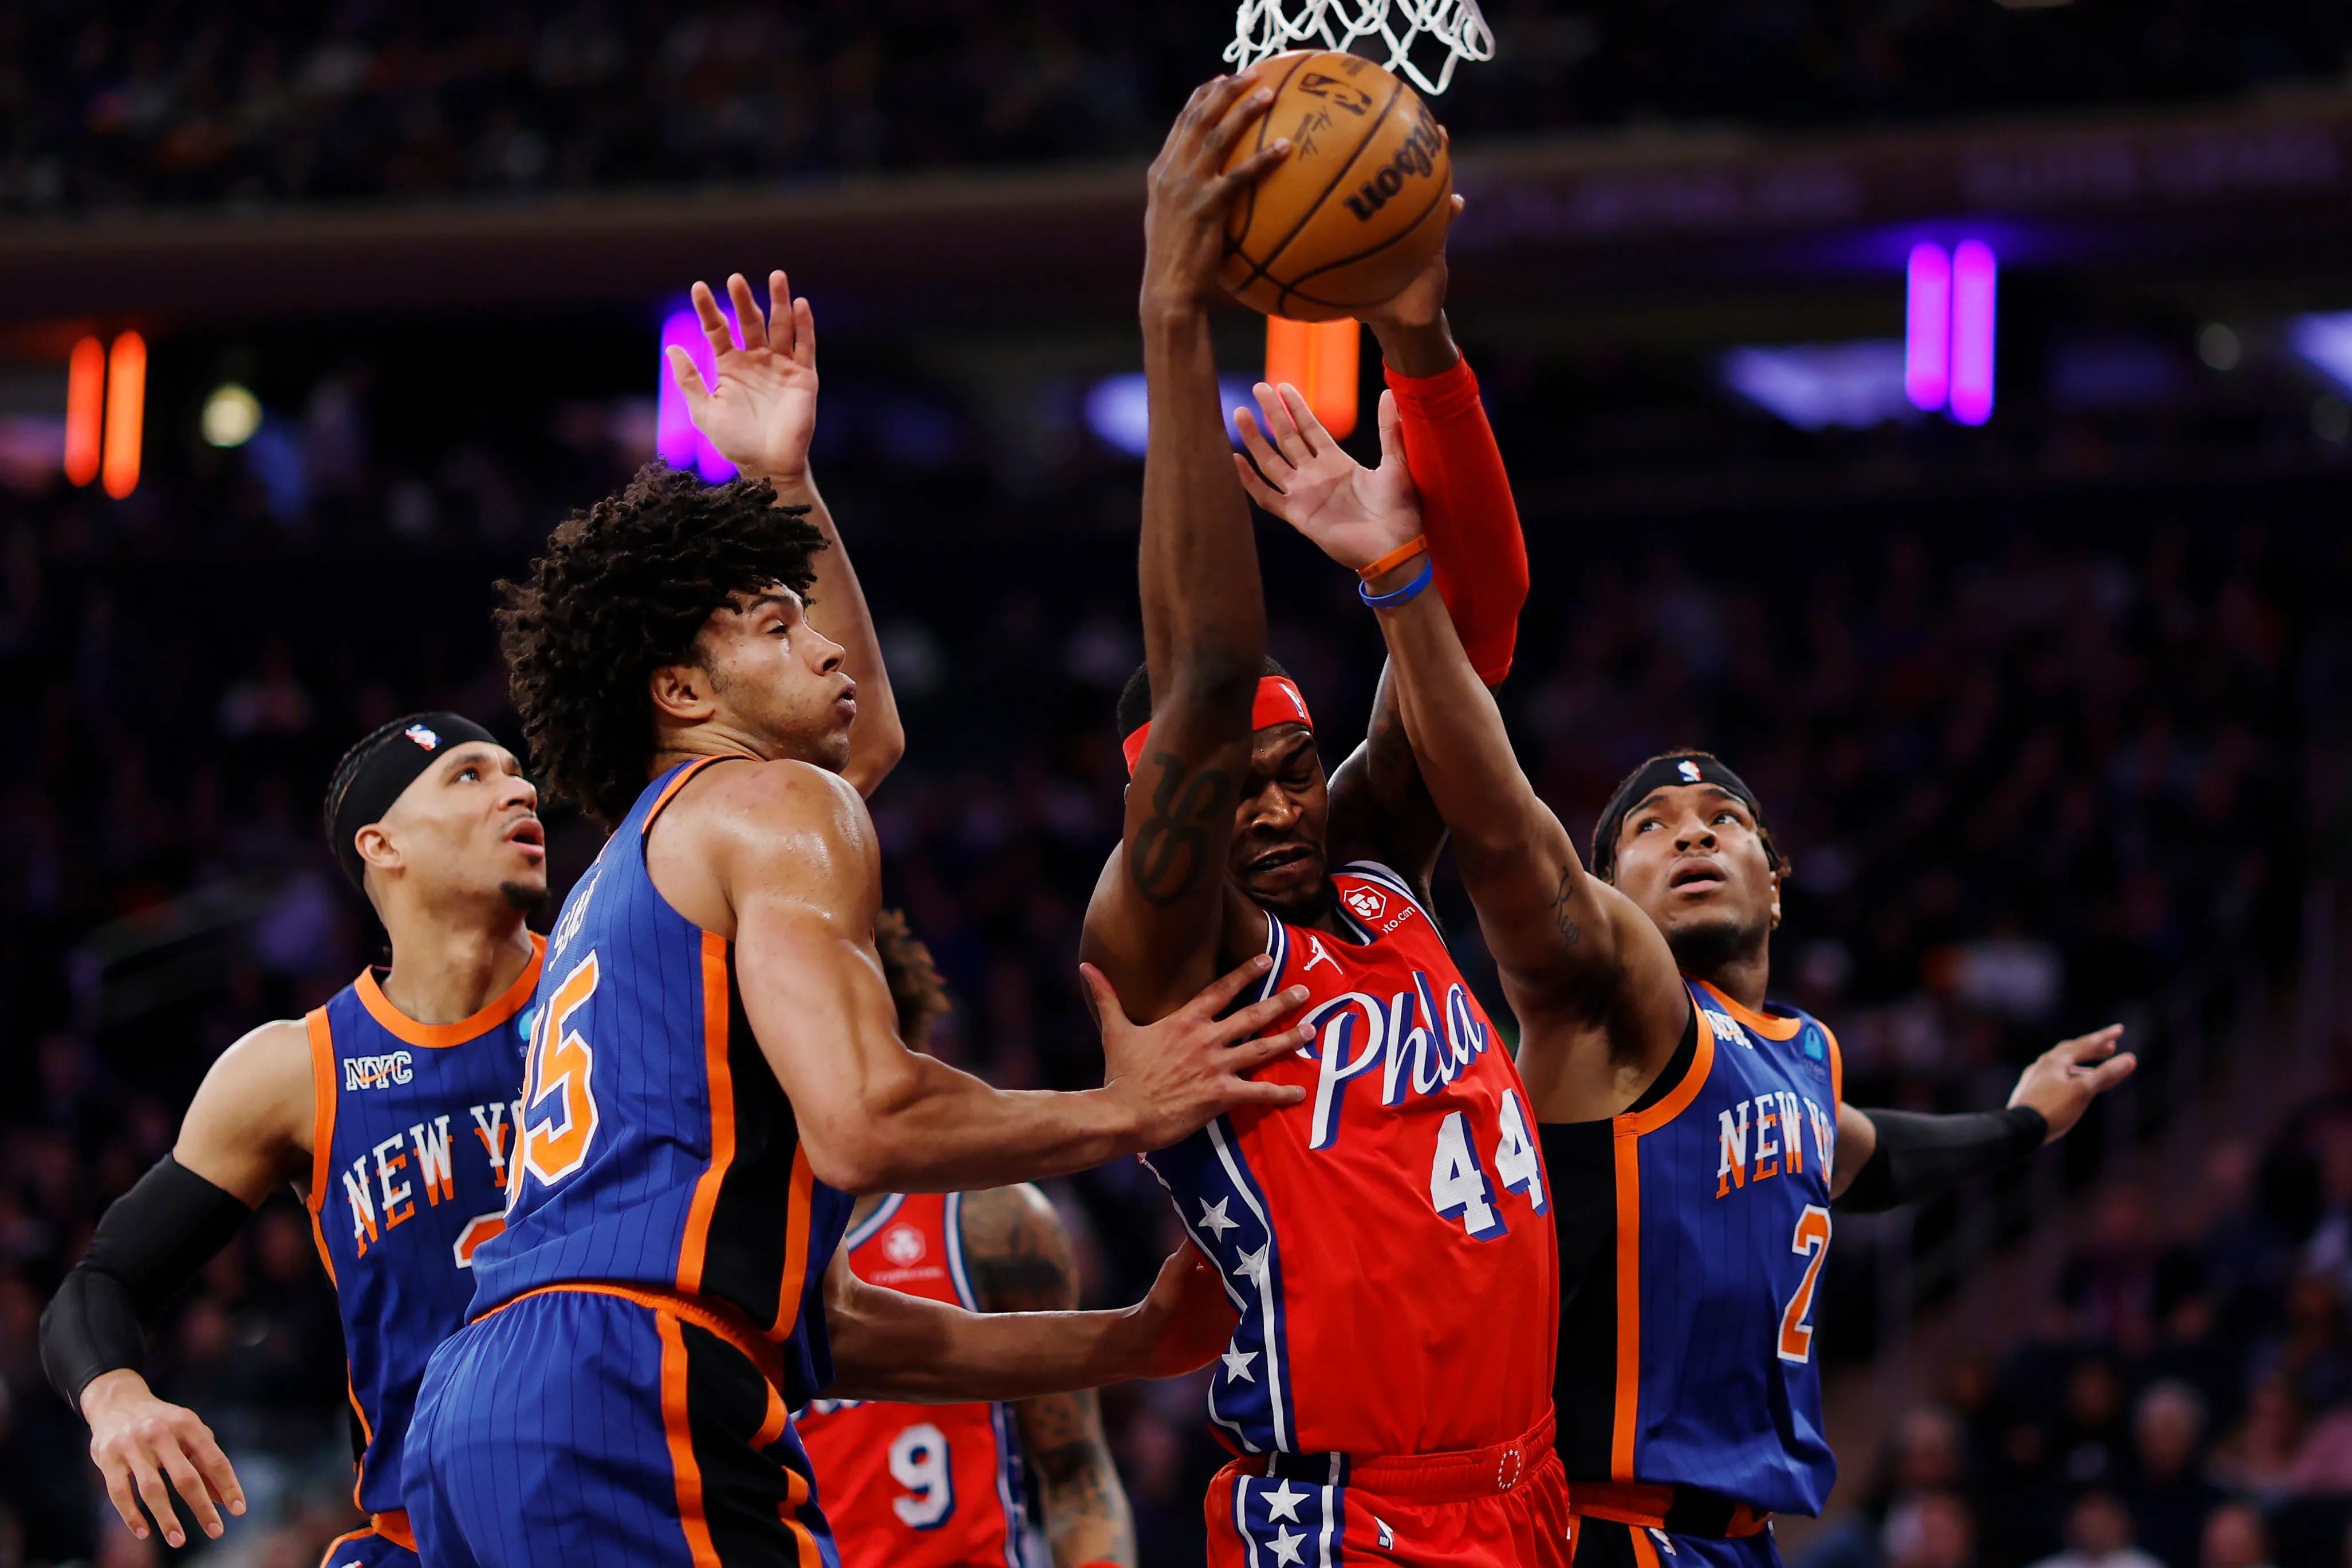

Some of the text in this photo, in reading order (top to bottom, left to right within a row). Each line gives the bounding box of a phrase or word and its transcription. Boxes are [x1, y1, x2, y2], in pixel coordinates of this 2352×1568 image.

[343, 1051, 413, 1092] NYC
[342, 1114, 455, 1259] NEW
[1429, 1088, 1549, 1242] 44
[1716, 1090, 1803, 1199] NEW
[1776, 1203, 1832, 1364] 2
[889, 1423, 957, 1532] 9
